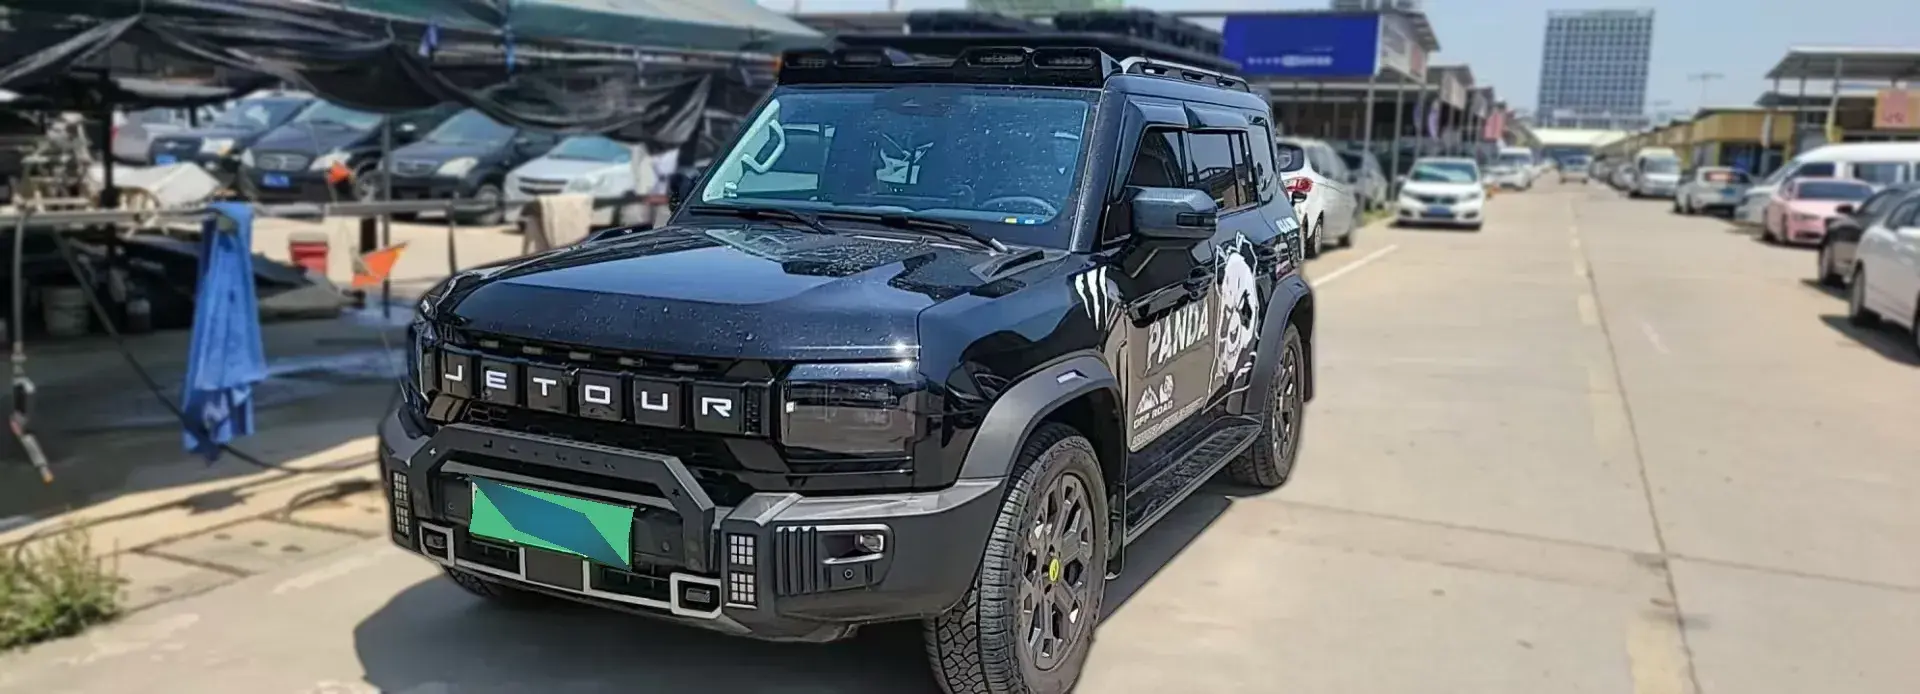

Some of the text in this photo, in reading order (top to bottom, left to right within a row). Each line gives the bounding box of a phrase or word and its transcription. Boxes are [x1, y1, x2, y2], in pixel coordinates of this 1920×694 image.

[1145, 297, 1209, 375] PANDA
[445, 364, 732, 418] JETOUR
[1133, 412, 1151, 430] OFF
[1151, 399, 1173, 419] ROAD
